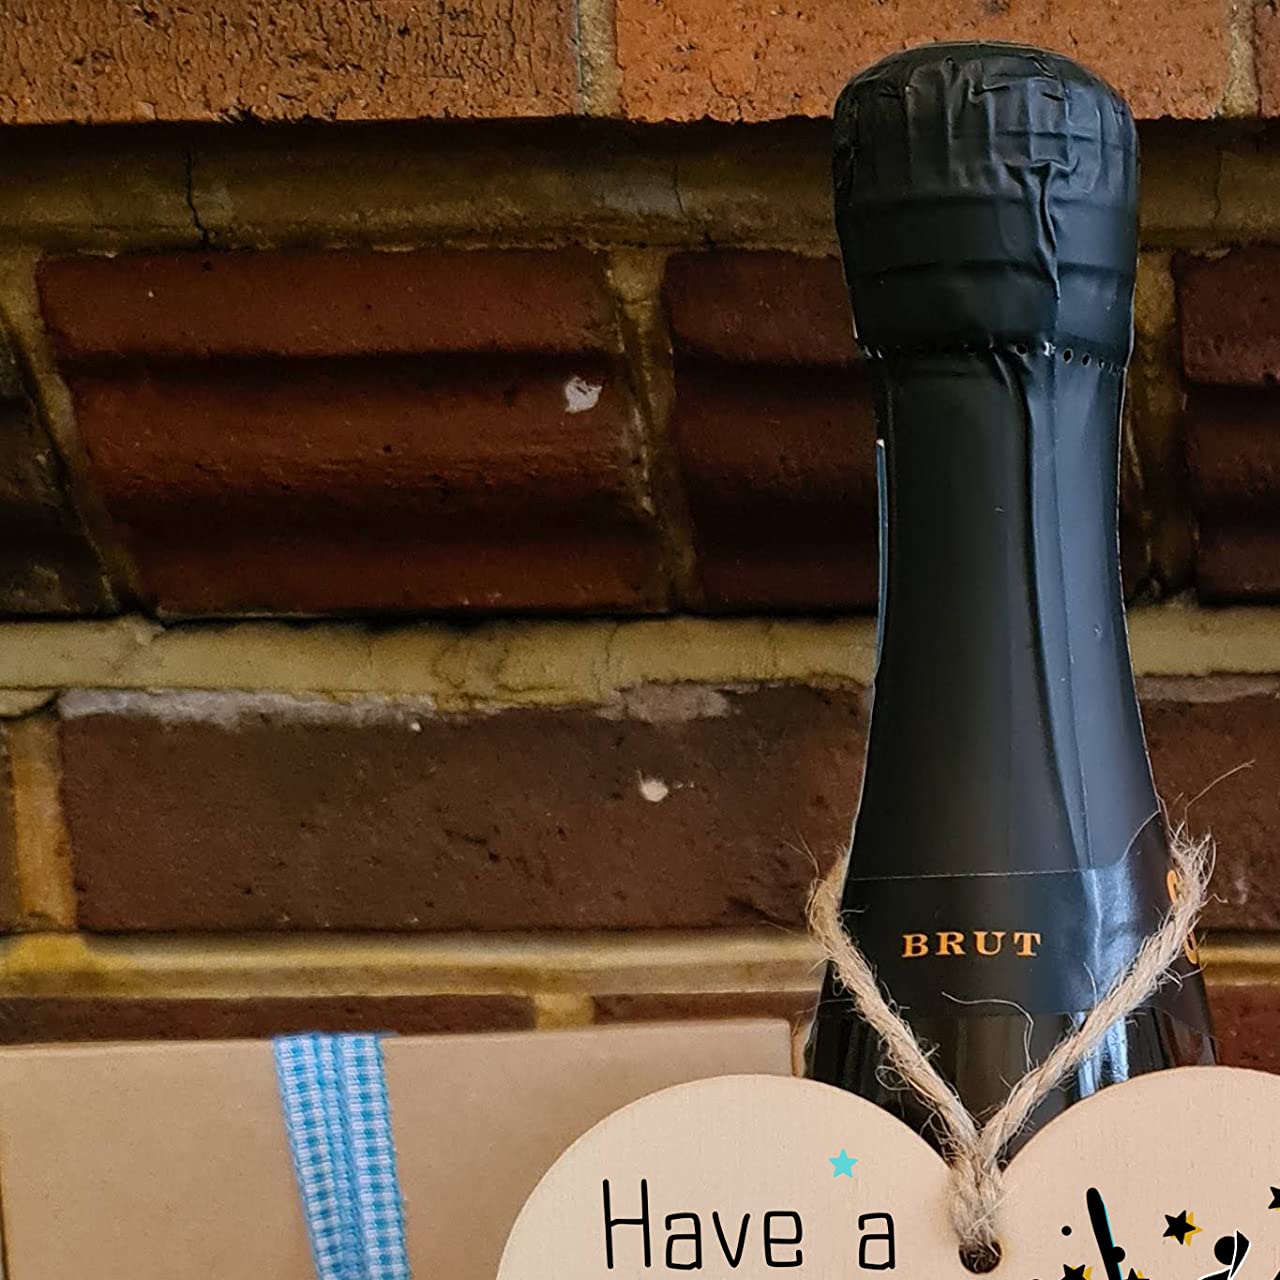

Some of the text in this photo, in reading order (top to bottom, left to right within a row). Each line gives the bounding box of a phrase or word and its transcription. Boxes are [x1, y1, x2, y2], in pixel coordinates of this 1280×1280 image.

[902, 931, 1041, 958] BRUT
[602, 1179, 896, 1270] Have a
